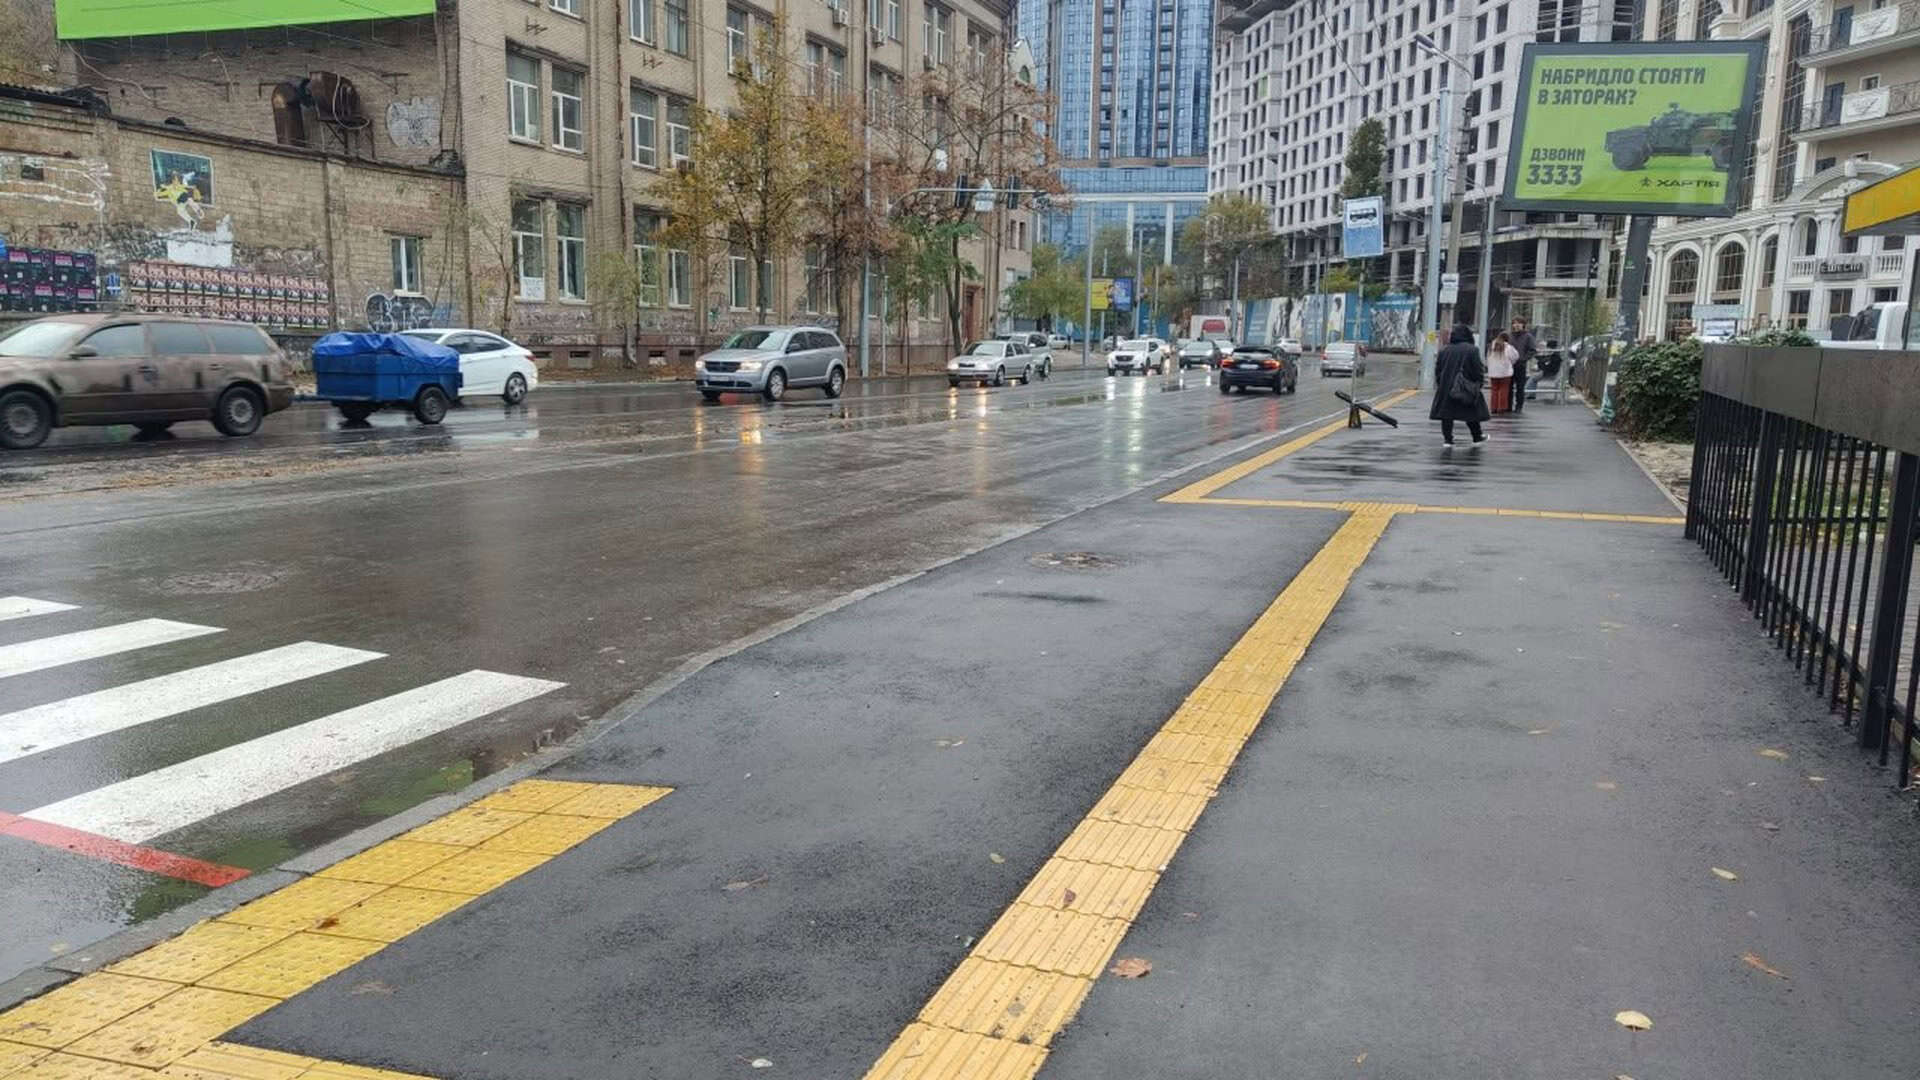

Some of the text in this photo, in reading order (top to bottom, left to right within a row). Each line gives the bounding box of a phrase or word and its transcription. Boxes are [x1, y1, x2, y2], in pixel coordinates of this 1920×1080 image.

[1540, 67, 1705, 85] НАБРИДЛО СТОЯТИ
[1537, 88, 1637, 105] В ЗАТОРАХ?
[1530, 148, 1586, 162] ДЗВОНИ
[1526, 164, 1583, 185] 3333
